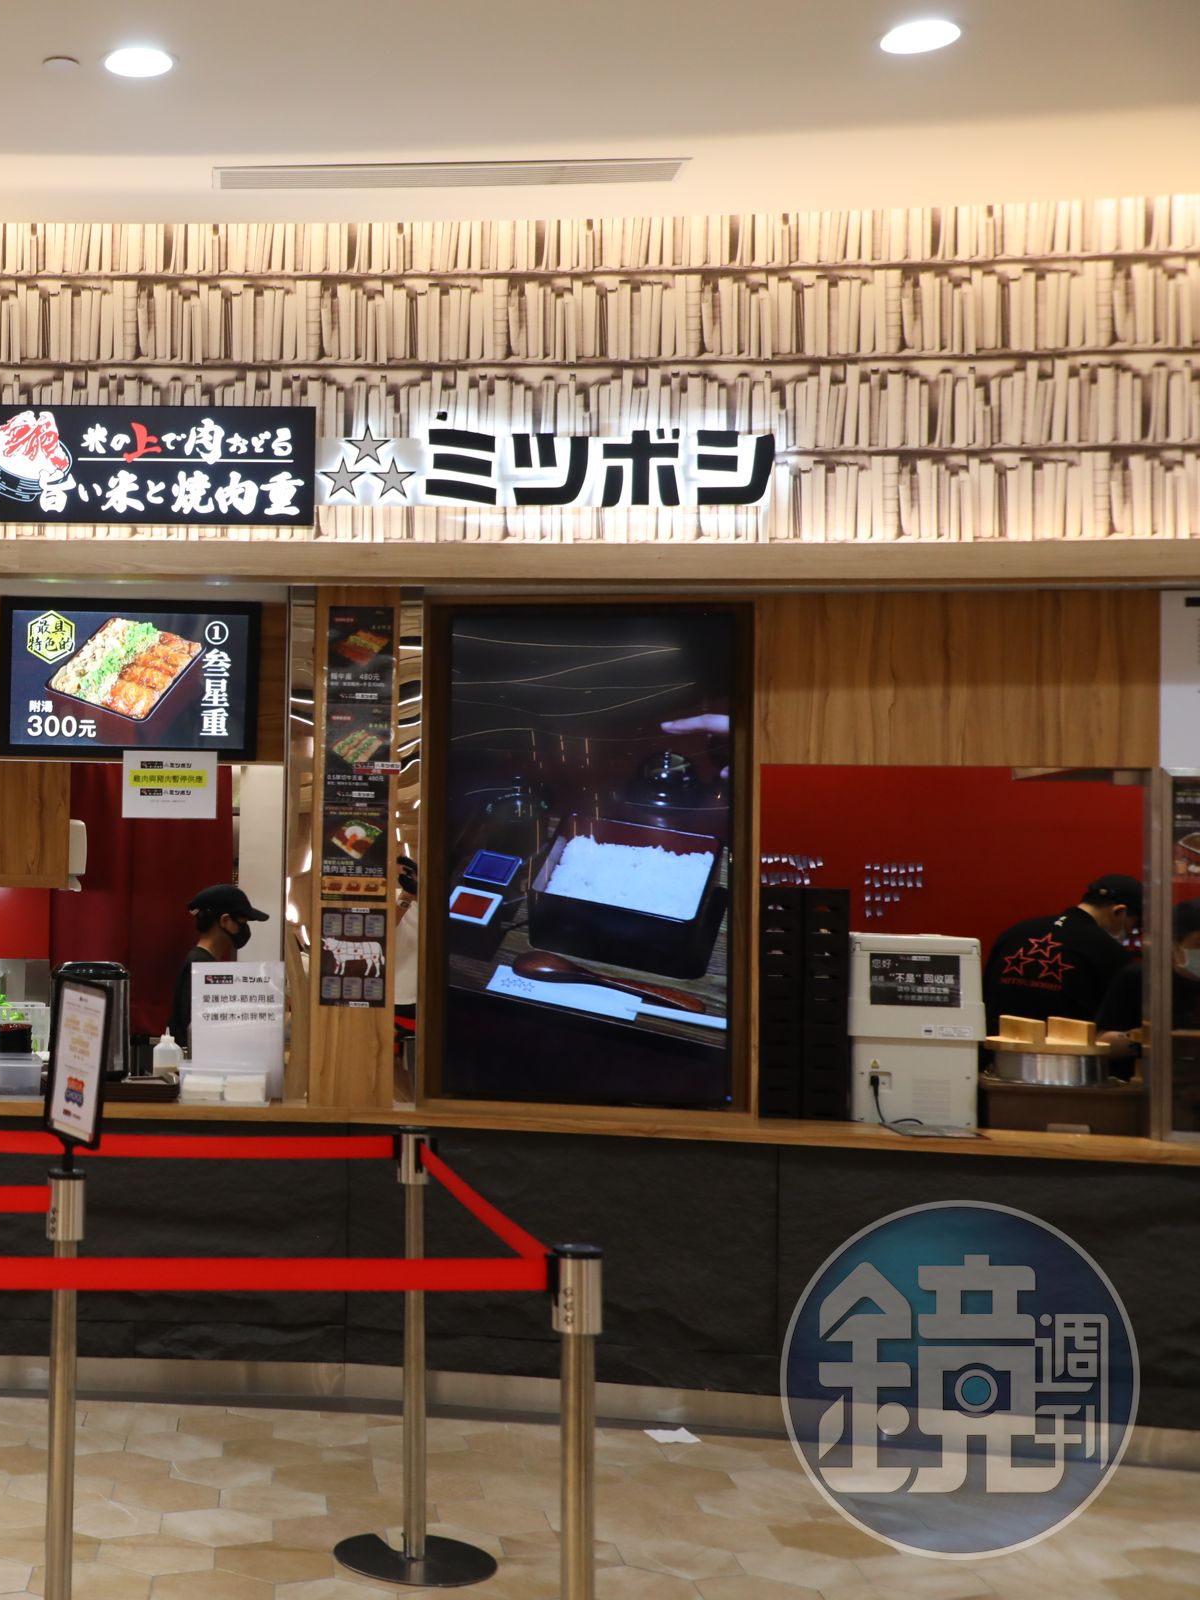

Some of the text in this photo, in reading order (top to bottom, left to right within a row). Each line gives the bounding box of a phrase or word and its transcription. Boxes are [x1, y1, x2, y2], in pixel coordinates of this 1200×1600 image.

[81, 419, 292, 464] 米の上で肉おどる
[425, 428, 776, 507] ミツボシ
[28, 636, 74, 652] 特色的
[29, 700, 53, 713] 附湯
[27, 716, 97, 737] 300元
[923, 973, 955, 984] 回收區
